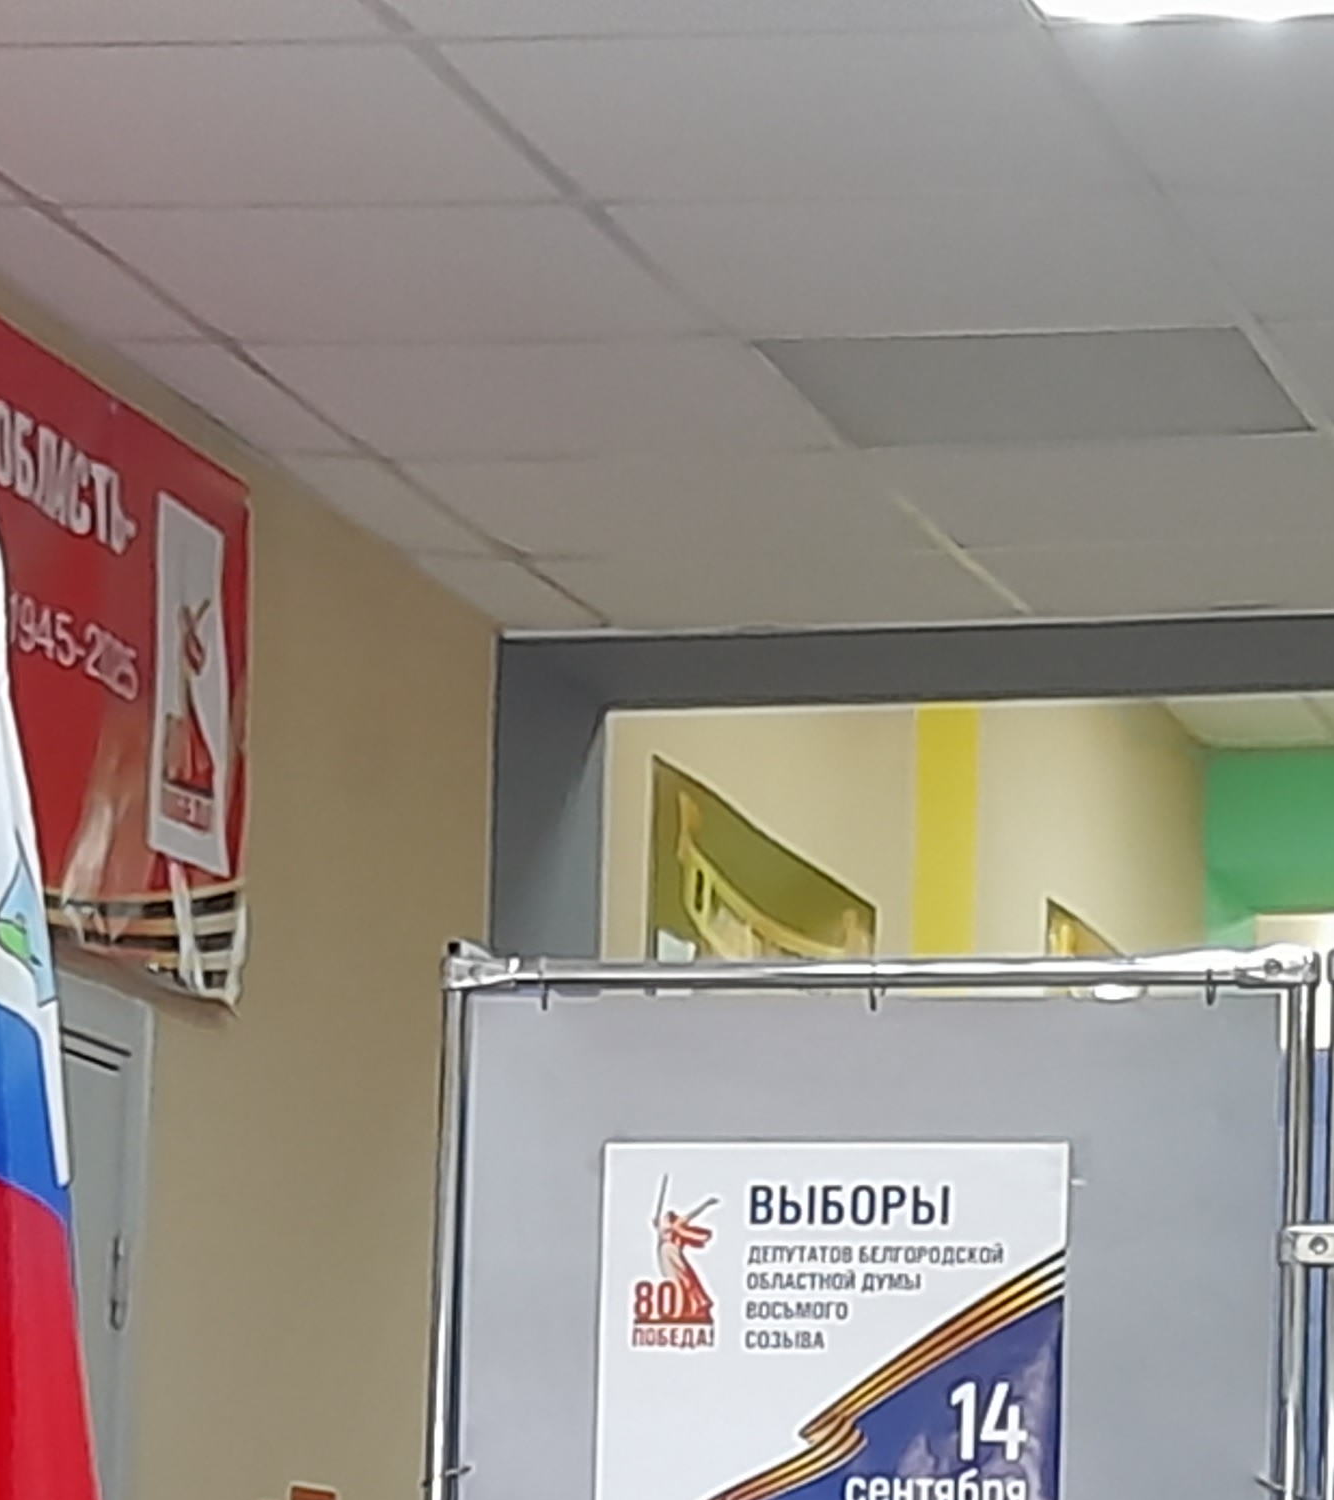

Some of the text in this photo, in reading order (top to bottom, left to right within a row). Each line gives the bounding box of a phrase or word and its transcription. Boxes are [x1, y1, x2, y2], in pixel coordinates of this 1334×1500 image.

[749, 1184, 951, 1226] ВЫБОРЫ
[746, 1243, 1004, 1266] ДЕПУТАТОВ БЕЛГОРОДСКОЙ
[746, 1270, 922, 1293] ОБЛАСТНОЙ ДУМЫ
[633, 1281, 679, 1319] 80
[745, 1300, 849, 1320] ВОСЬМОГО
[631, 1327, 715, 1349] ПОБЕДА!
[745, 1331, 825, 1350] СОЗЫВА
[950, 1381, 1028, 1461] 14
